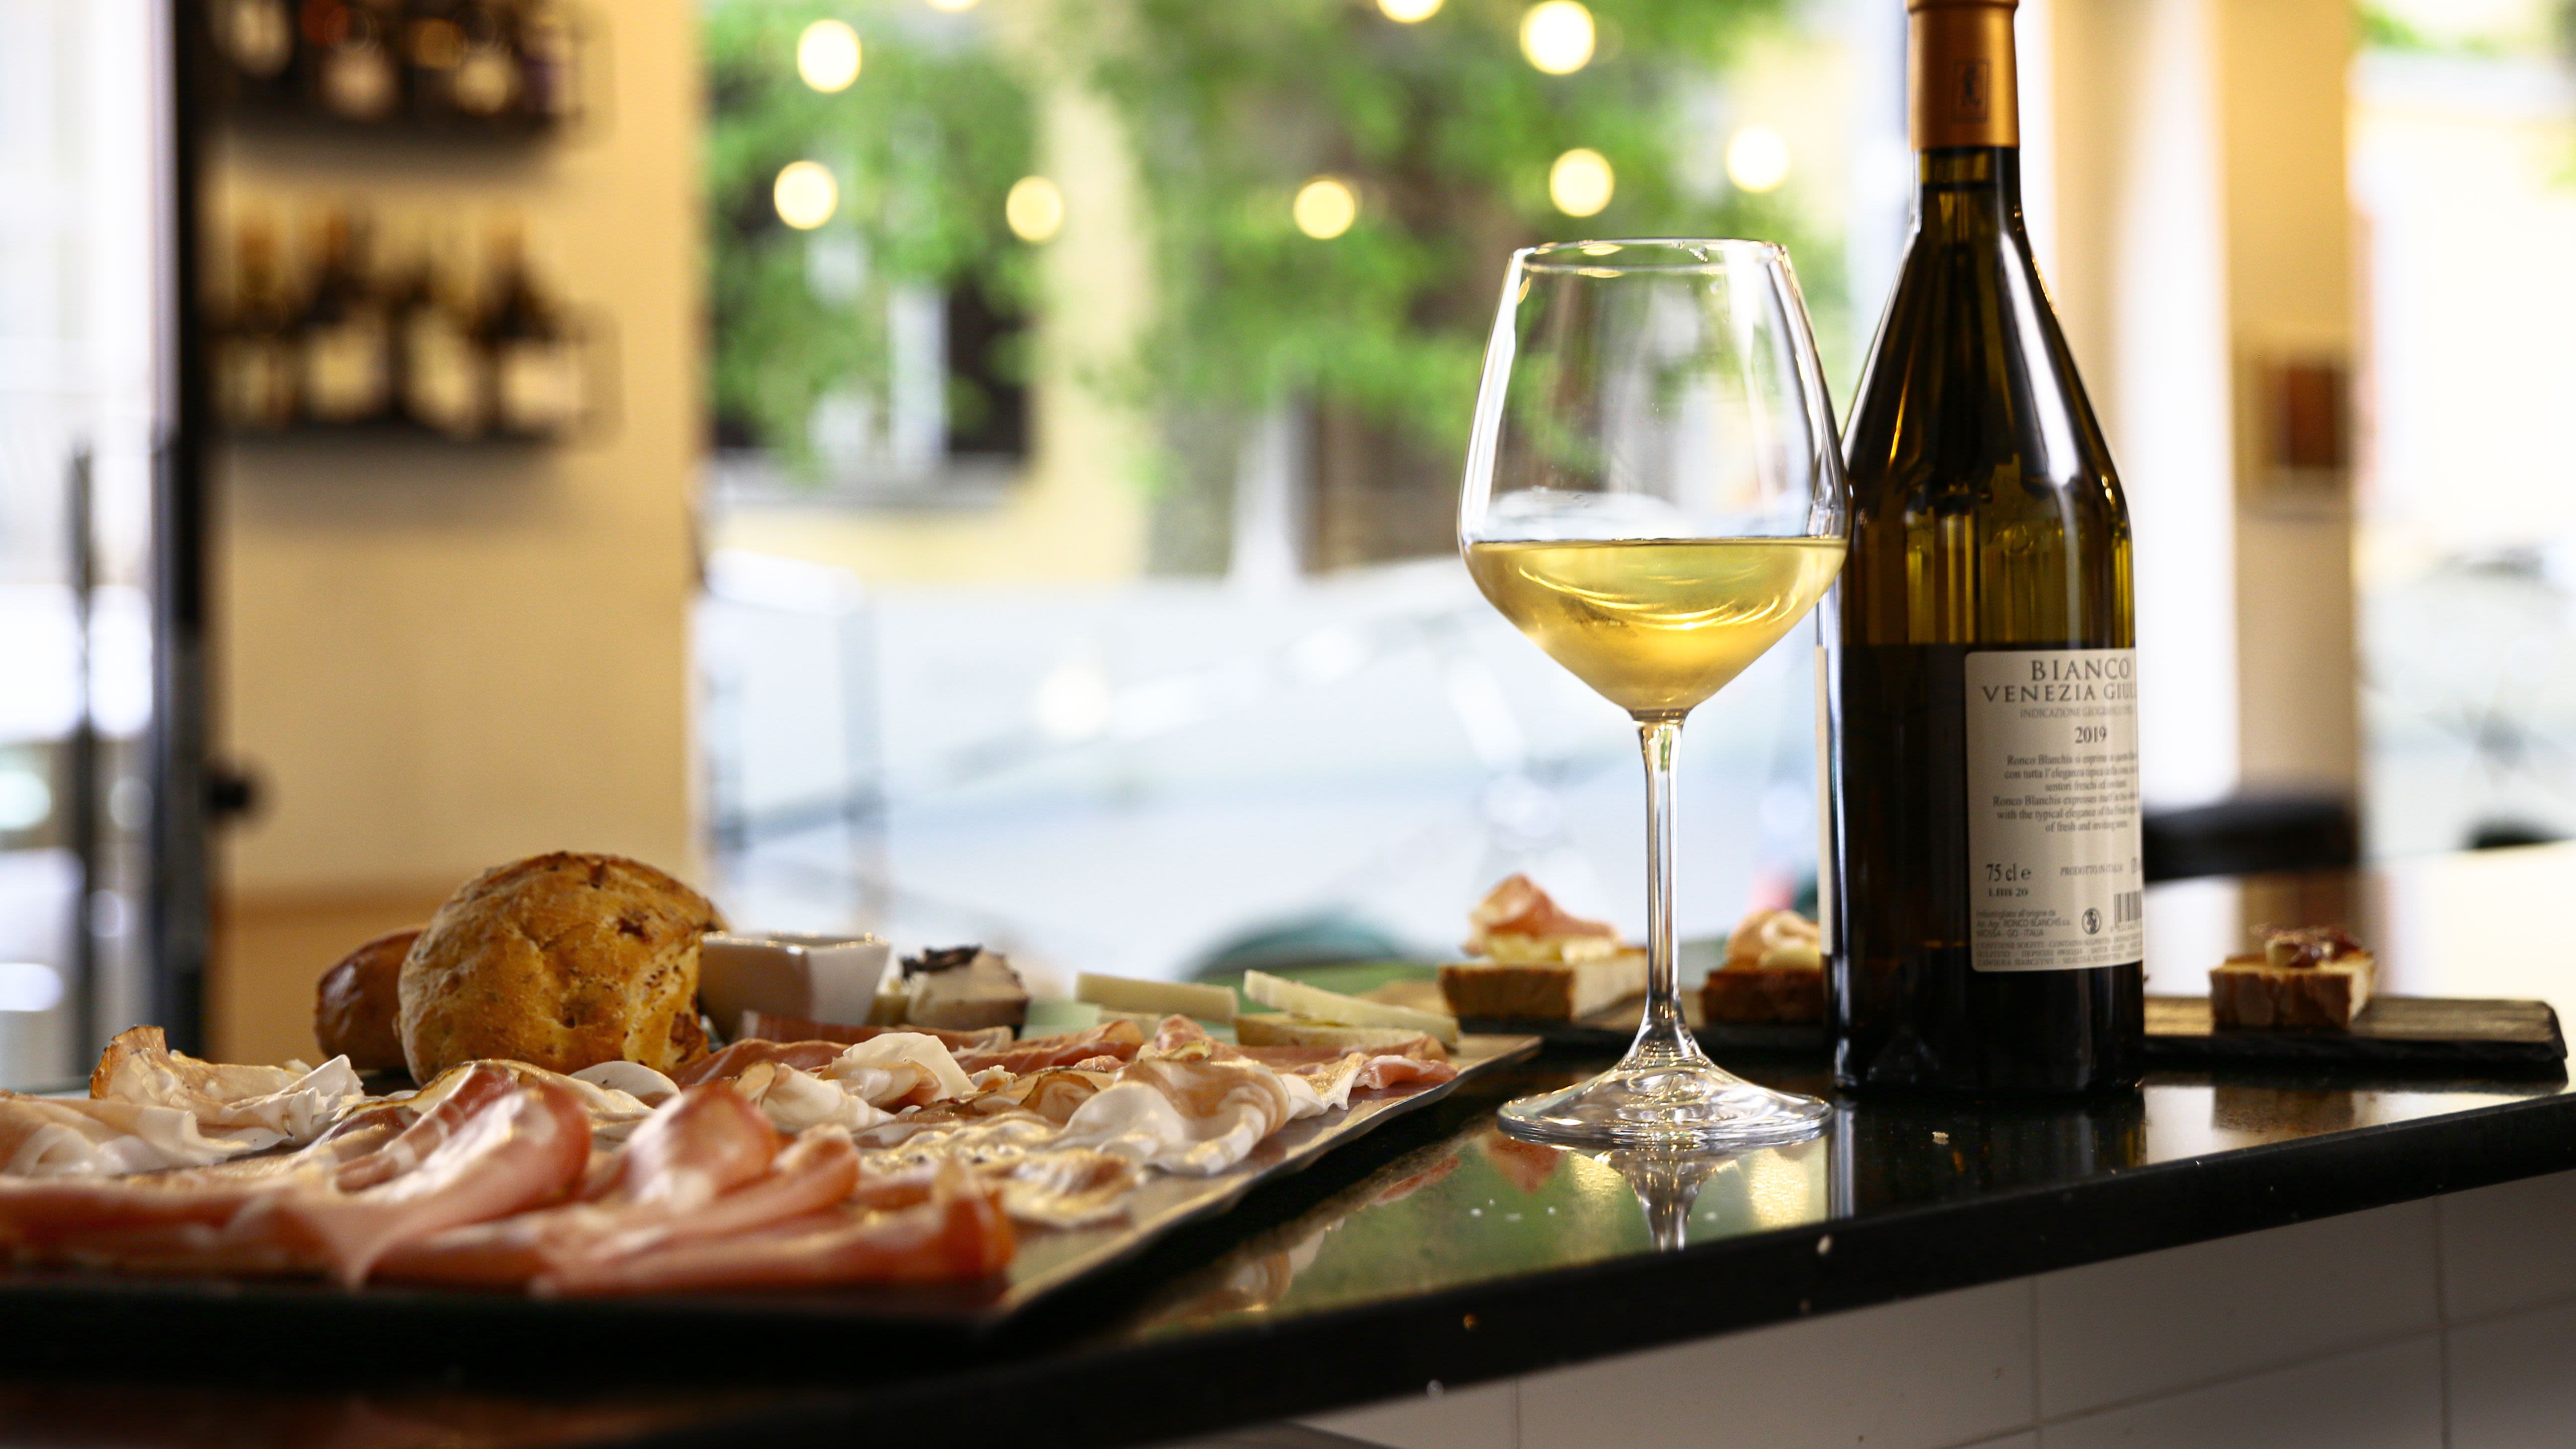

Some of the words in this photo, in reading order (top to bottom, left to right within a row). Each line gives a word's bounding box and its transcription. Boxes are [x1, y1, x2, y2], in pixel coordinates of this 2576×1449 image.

[2031, 657, 2131, 681] BIANCO
[1983, 684, 2096, 703] VENEZIA
[2075, 726, 2107, 743] 2019
[2007, 754, 2035, 765] Ronco
[2038, 753, 2073, 765] Blanchis
[1993, 795, 2022, 806] Ronco
[2024, 795, 2061, 805] Blanchis
[1997, 809, 2016, 819] with
[2019, 808, 2032, 819] the
[2035, 808, 2063, 821] typical
[2045, 821, 2055, 832] of
[1986, 863, 2002, 882] 75
[2006, 862, 2016, 882] cl
